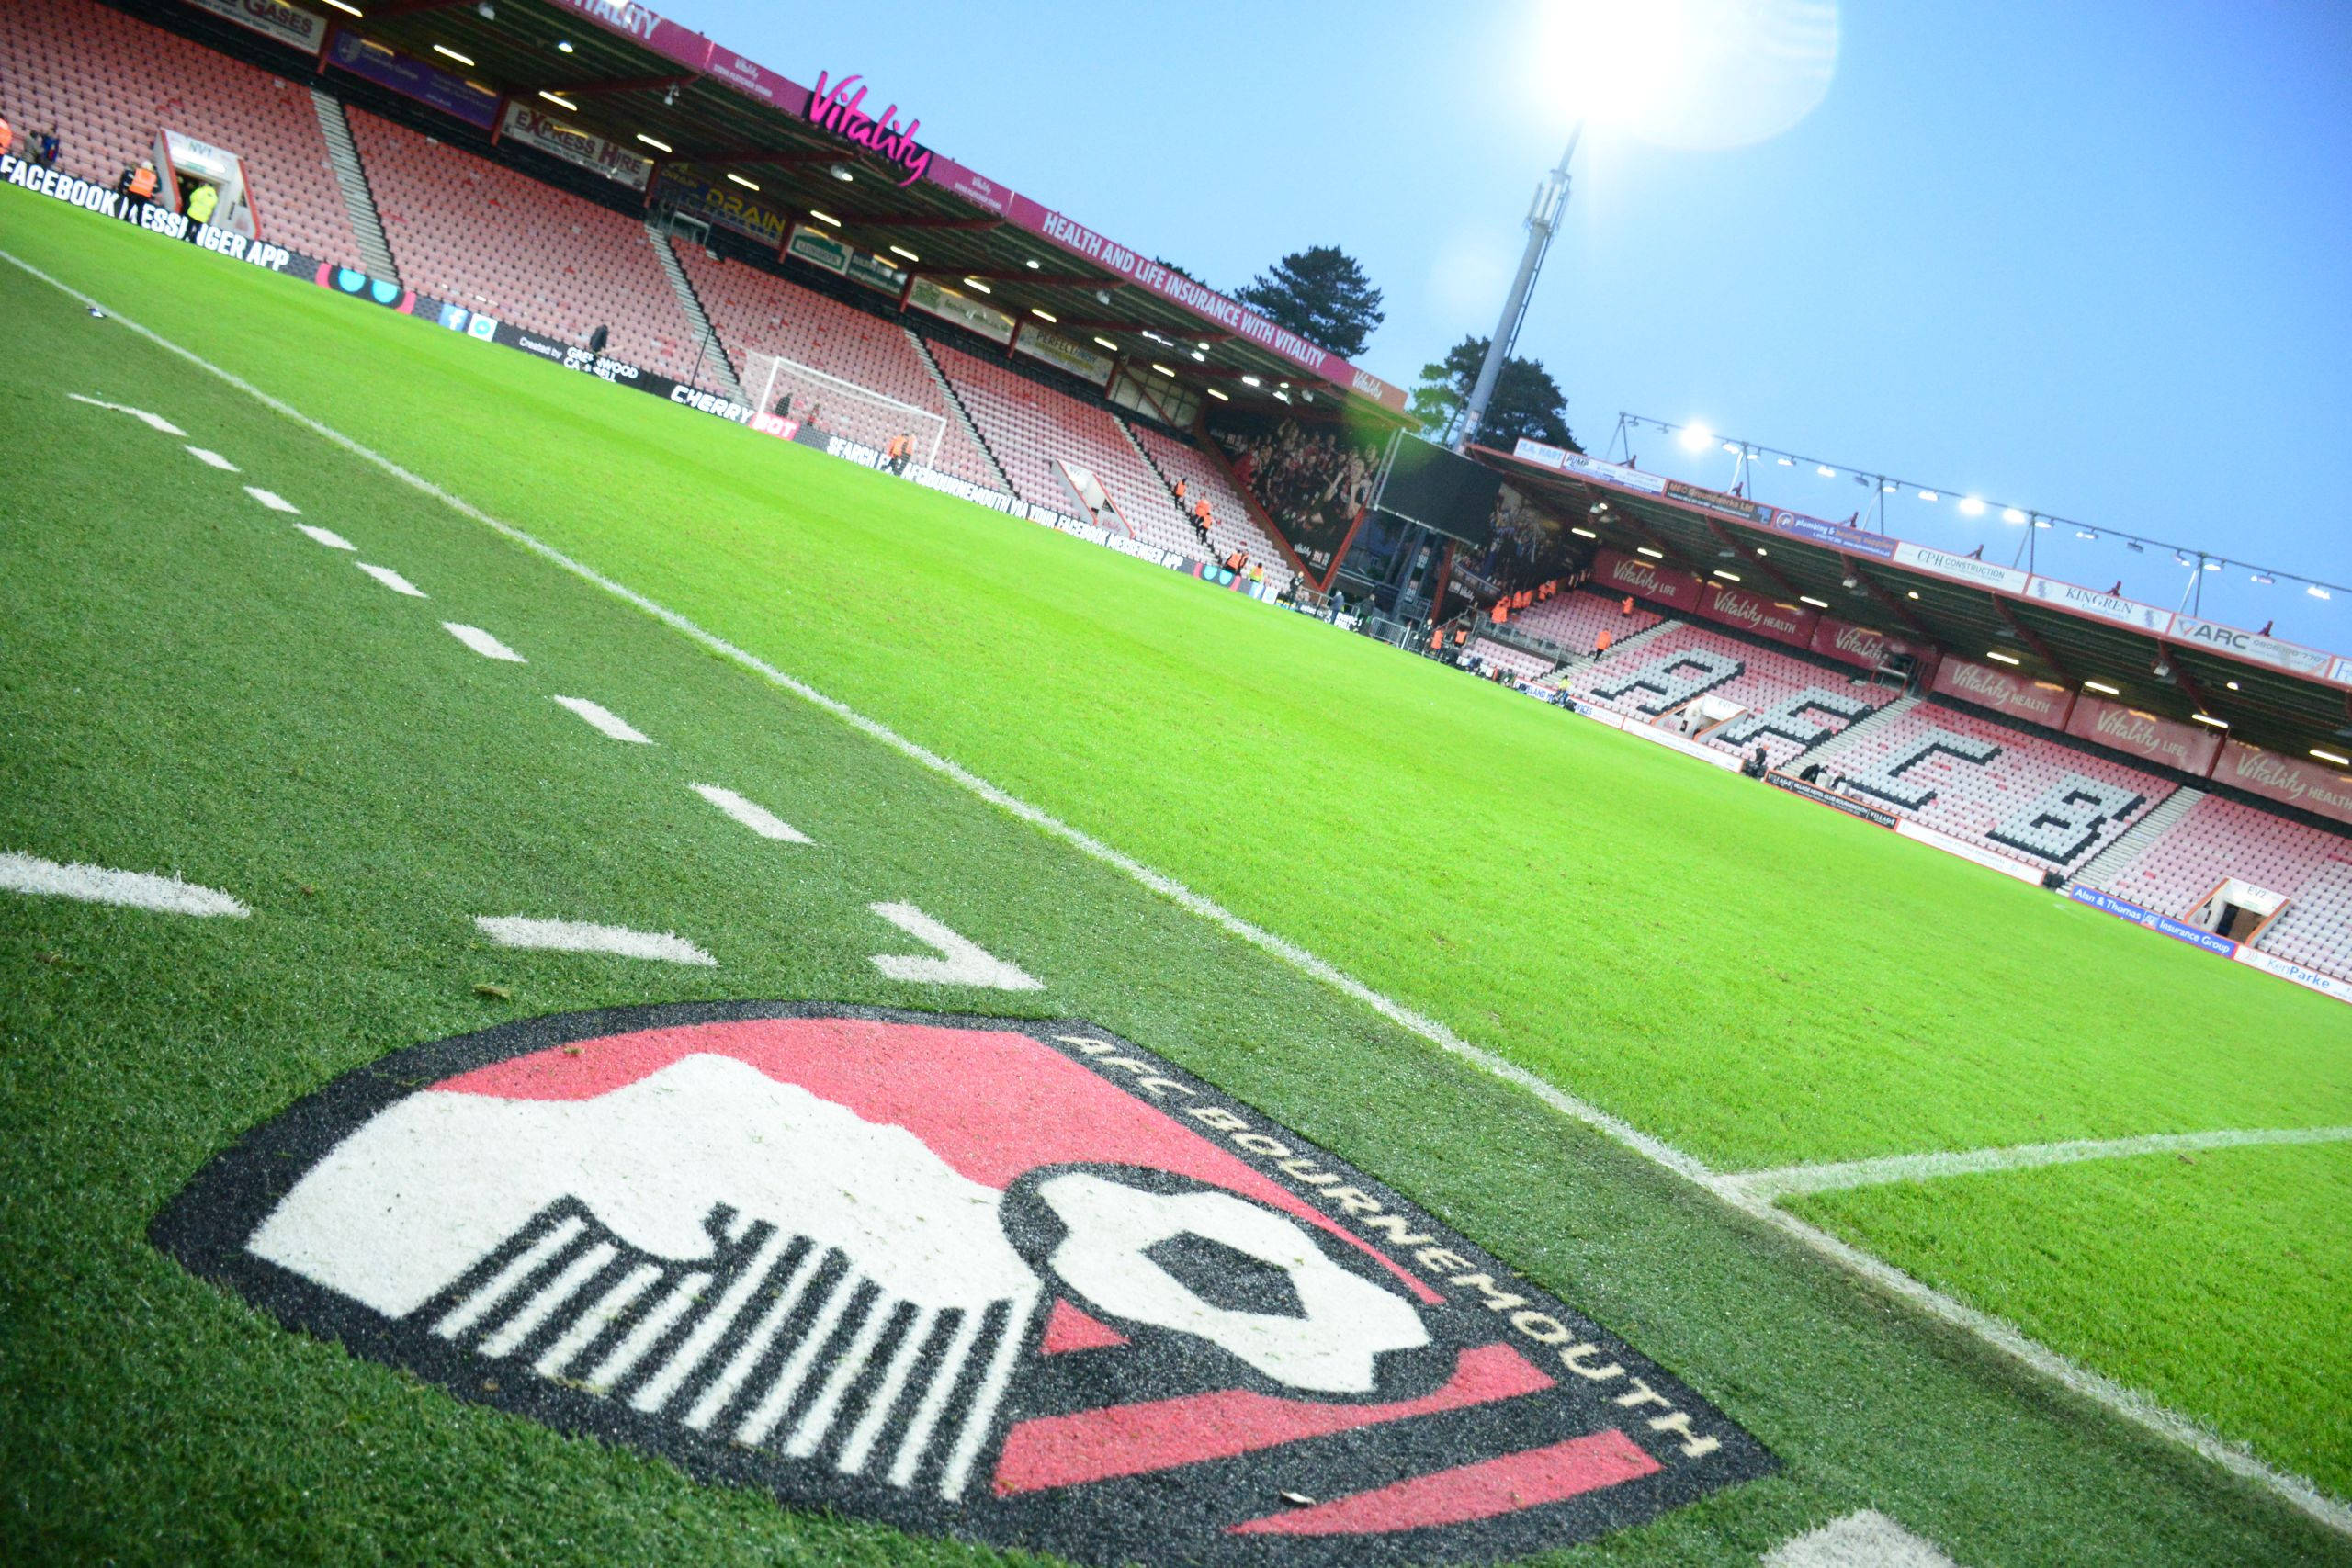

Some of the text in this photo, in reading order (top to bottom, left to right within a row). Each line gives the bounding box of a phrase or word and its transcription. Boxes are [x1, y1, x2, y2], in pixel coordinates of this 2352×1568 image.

[808, 70, 933, 188] Vitality
[0, 154, 119, 218] FACEBOOK
[245, 240, 289, 272] APP
[706, 187, 786, 234] DRAIN
[1042, 212, 1327, 368] HEALTH AND LIFE INSURANCE WITH VITALITY
[670, 384, 797, 438] CHERRY BOT
[827, 435, 879, 468] SEARCH
[1613, 559, 1677, 597] Vitality LIFE
[1917, 549, 1946, 567] CPH
[1944, 558, 2005, 580] CONSTRUCTION
[1713, 590, 1797, 634] Vitality HEALTH
[2065, 587, 2134, 614] KINGREN
[2194, 624, 2251, 650] ARC
[1951, 663, 2052, 714] Vitality HEALTH
[2096, 709, 2187, 756] Vitality LIFE
[2237, 752, 2352, 810] Vitality HEALTH
[2246, 886, 2267, 899] EV2
[2074, 888, 2096, 903] Alan
[2096, 896, 2104, 906] &
[2107, 898, 2142, 919] Thomas
[2160, 919, 2199, 942] Insurance
[2201, 935, 2231, 956] Group
[1057, 1034, 1724, 1460] AFC BOURNEMOUTH
